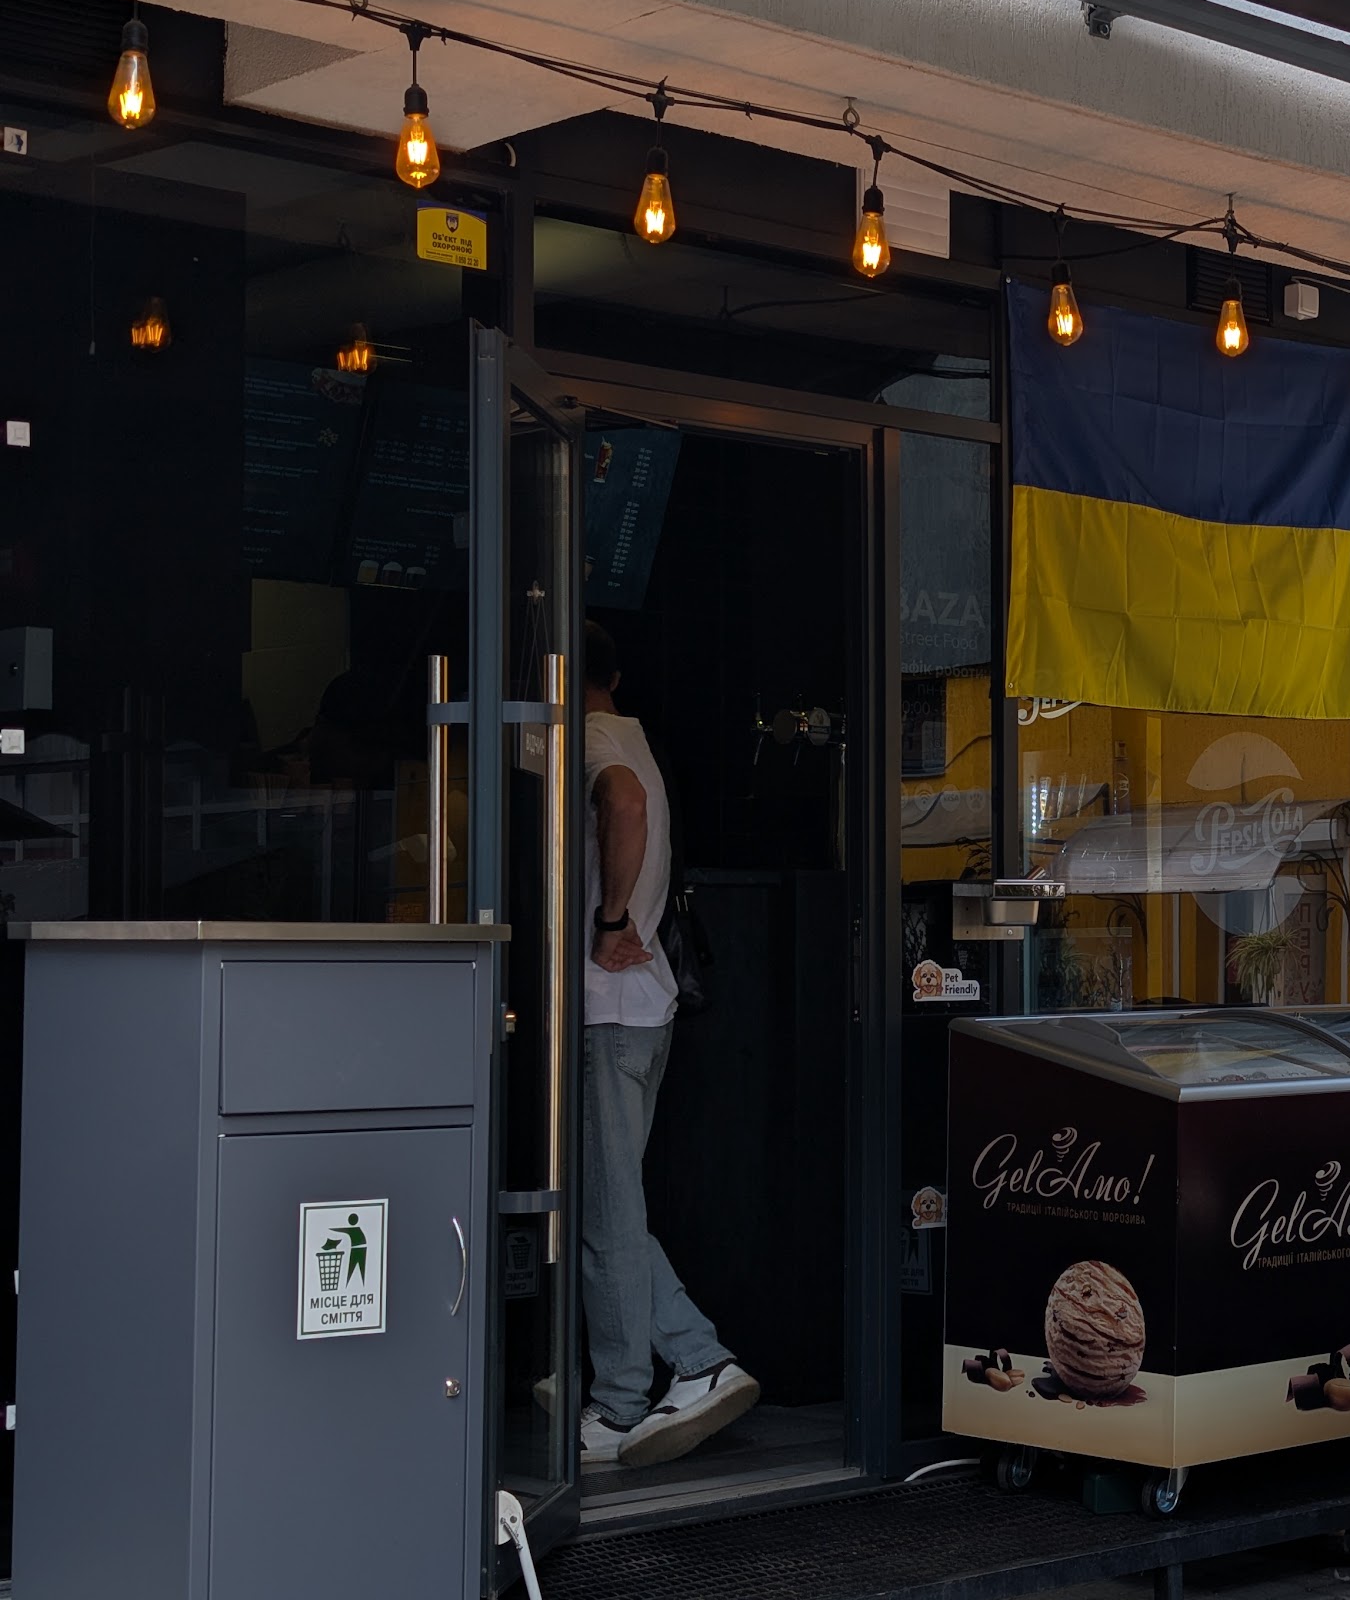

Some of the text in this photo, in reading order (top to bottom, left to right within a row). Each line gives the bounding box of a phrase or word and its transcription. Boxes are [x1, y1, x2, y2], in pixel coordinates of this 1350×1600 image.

[943, 633, 977, 650] Food
[901, 659, 932, 677] афік
[902, 700, 930, 715] 0:00
[944, 973, 959, 983] Pet
[944, 984, 978, 997] Friendly
[1006, 1202, 1146, 1225] ТРАДИЦІЇ ІТАЛІЙСЬКОГО МОРОЗИВА
[1257, 1251, 1294, 1269] ТРАДИЦІЇ
[1296, 1246, 1350, 1264] ІТАЛІЙСЬКОГО
[310, 1293, 375, 1310] МІСЦЕ ДЛЯ
[321, 1310, 363, 1326] СМІТТЯ
